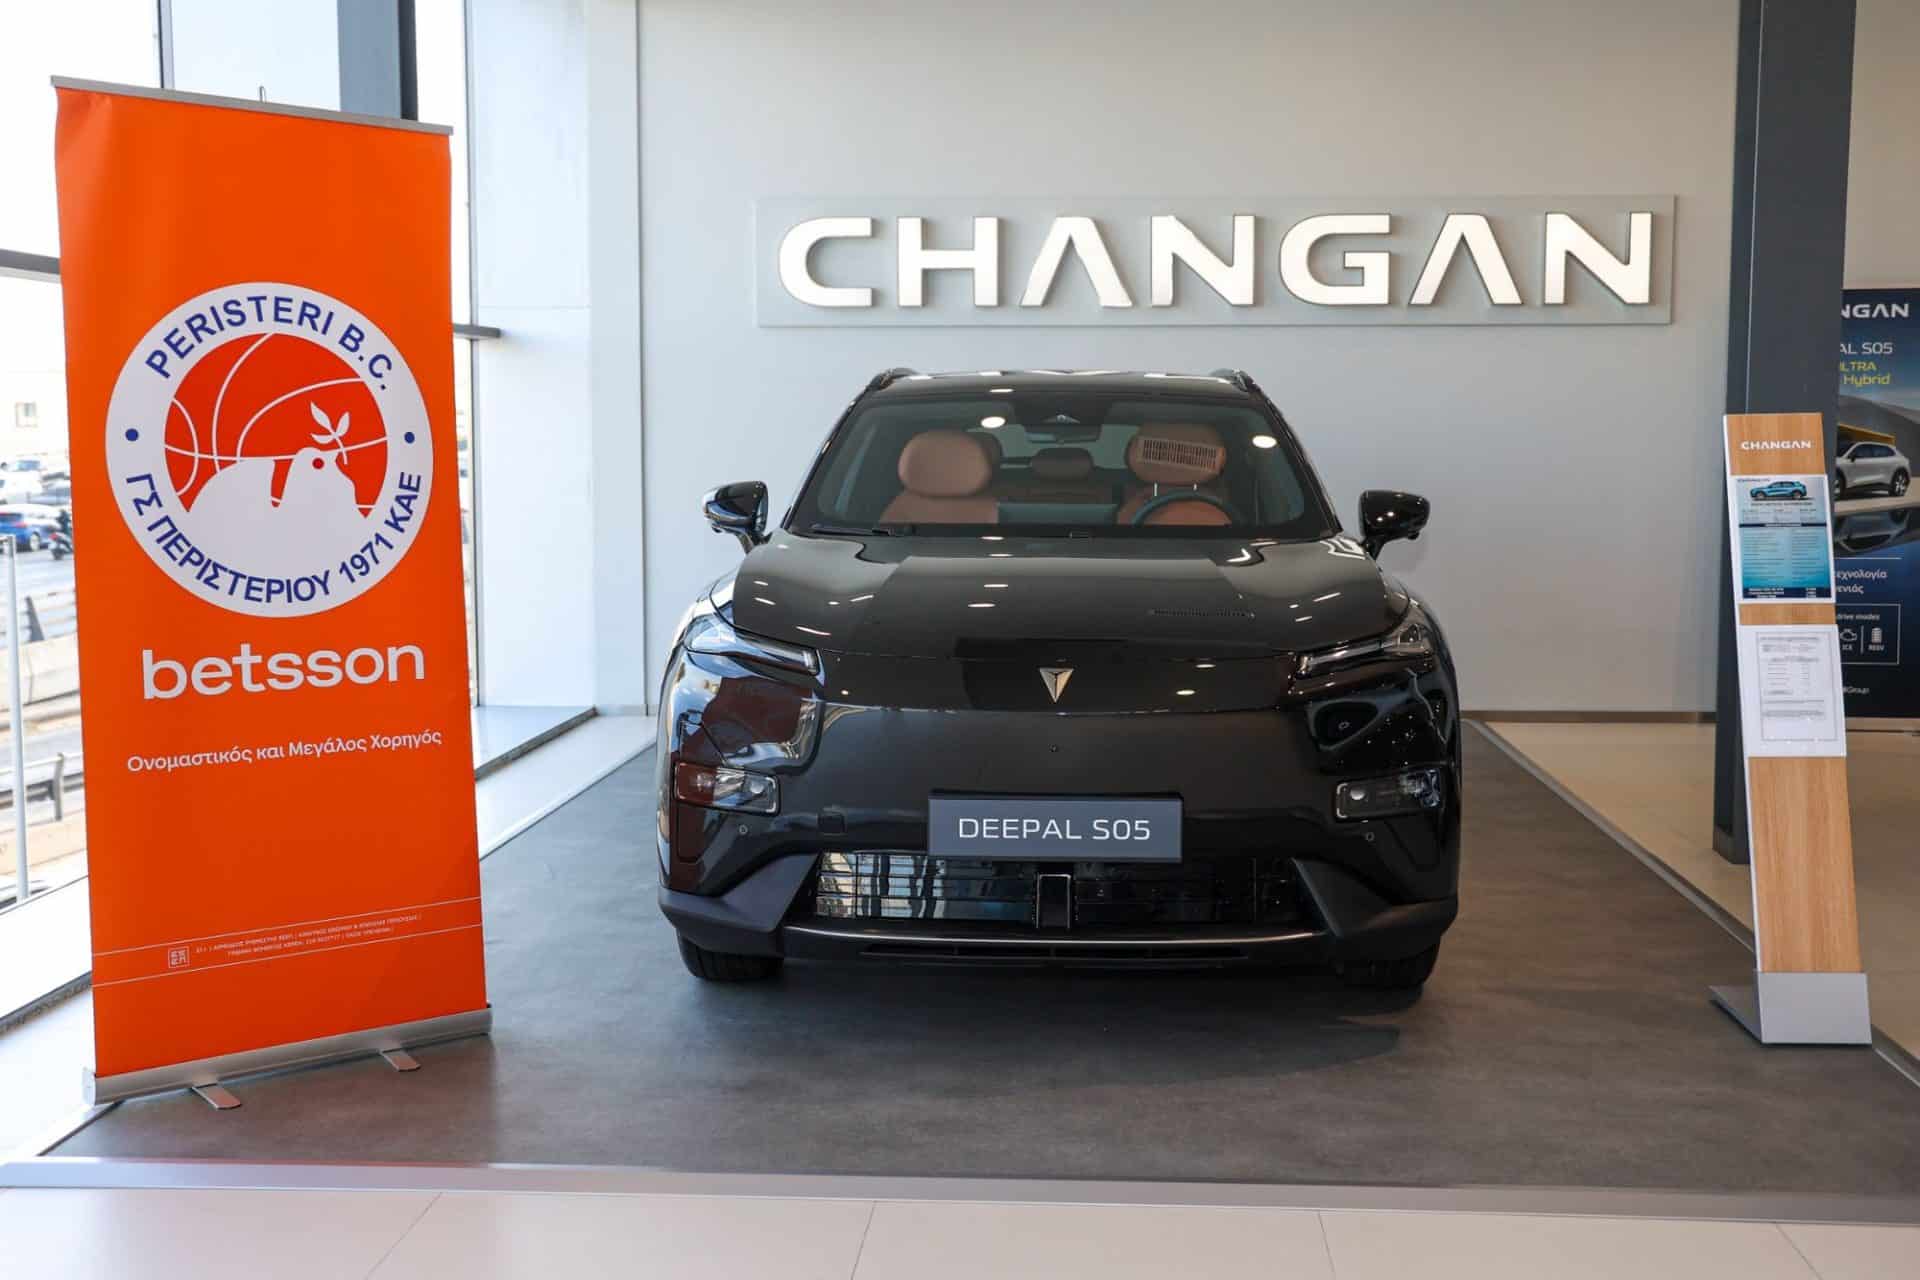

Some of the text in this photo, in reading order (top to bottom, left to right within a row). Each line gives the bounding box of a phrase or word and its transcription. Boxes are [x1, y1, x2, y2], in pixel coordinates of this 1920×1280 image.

[778, 212, 1653, 308] CHANGAN
[145, 294, 393, 391] PERISTERI B.C.
[1844, 374, 1890, 387] Hybrid
[1741, 440, 1811, 450] CHANGAN
[125, 470, 422, 604] ΓΣ ΠΕΡΙΣΤΕΡΙΟΥ 1971 ΚΑΕ
[142, 642, 425, 700] betsson
[127, 729, 442, 774] Ονομαστικός και Μεγάλος Χορηγός
[959, 818, 1151, 841] DEEPAL S05
